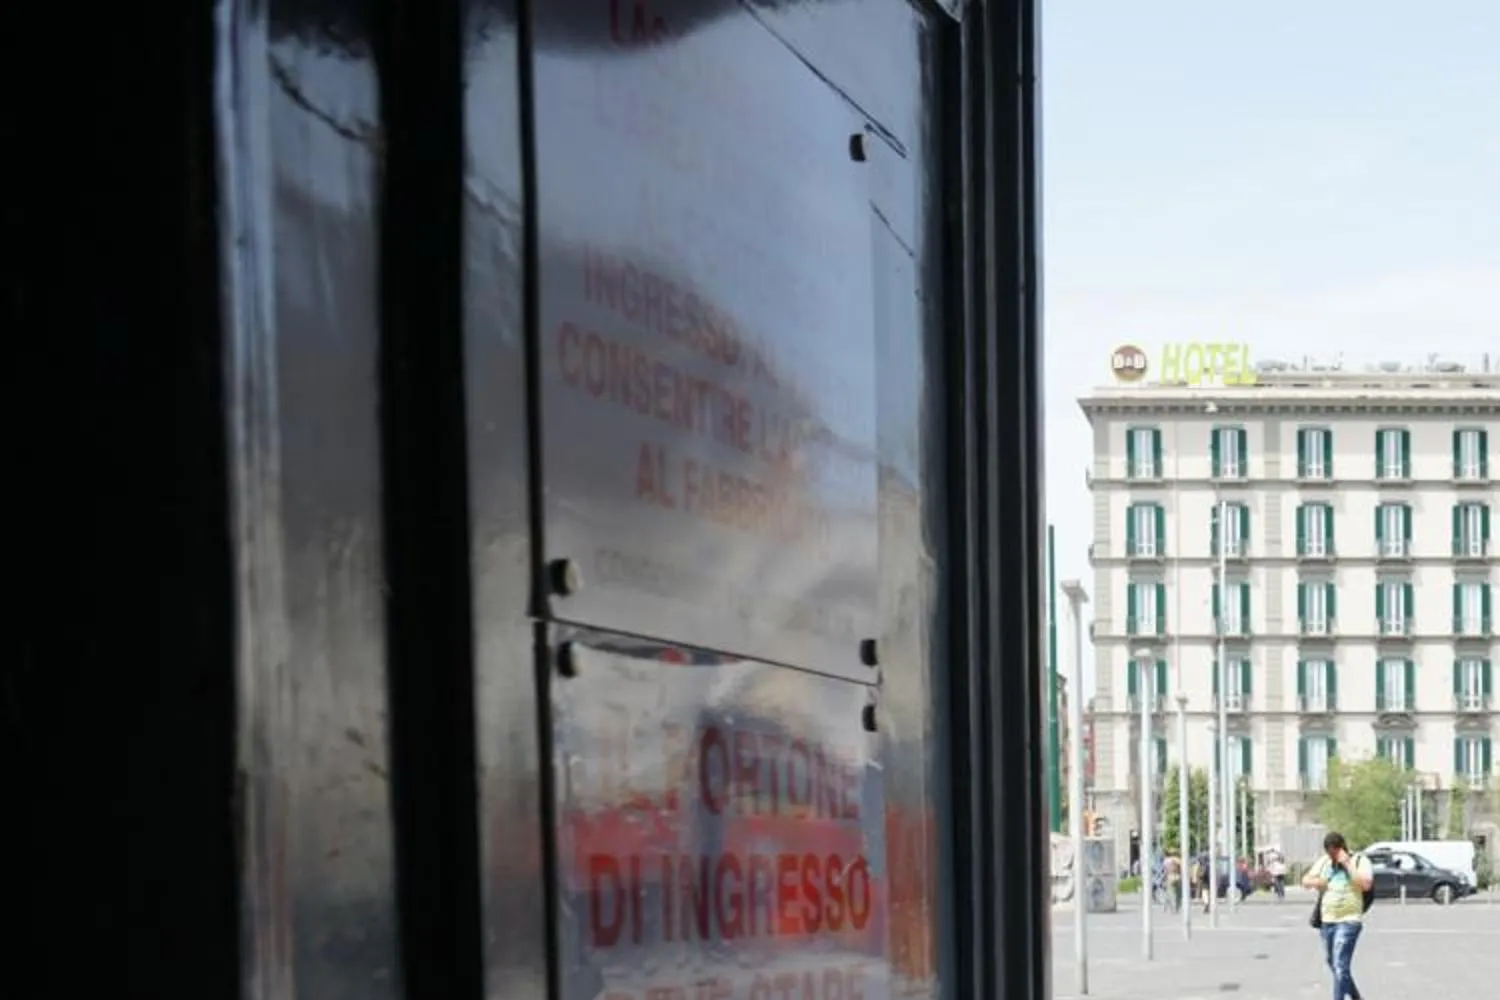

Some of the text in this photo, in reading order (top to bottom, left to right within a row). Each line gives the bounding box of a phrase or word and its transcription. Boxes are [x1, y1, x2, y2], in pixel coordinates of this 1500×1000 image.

[1159, 342, 1258, 385] HOTEL
[634, 440, 677, 509] AL
[655, 718, 861, 822] ORTONE
[588, 851, 871, 949] DI INGRESSO
